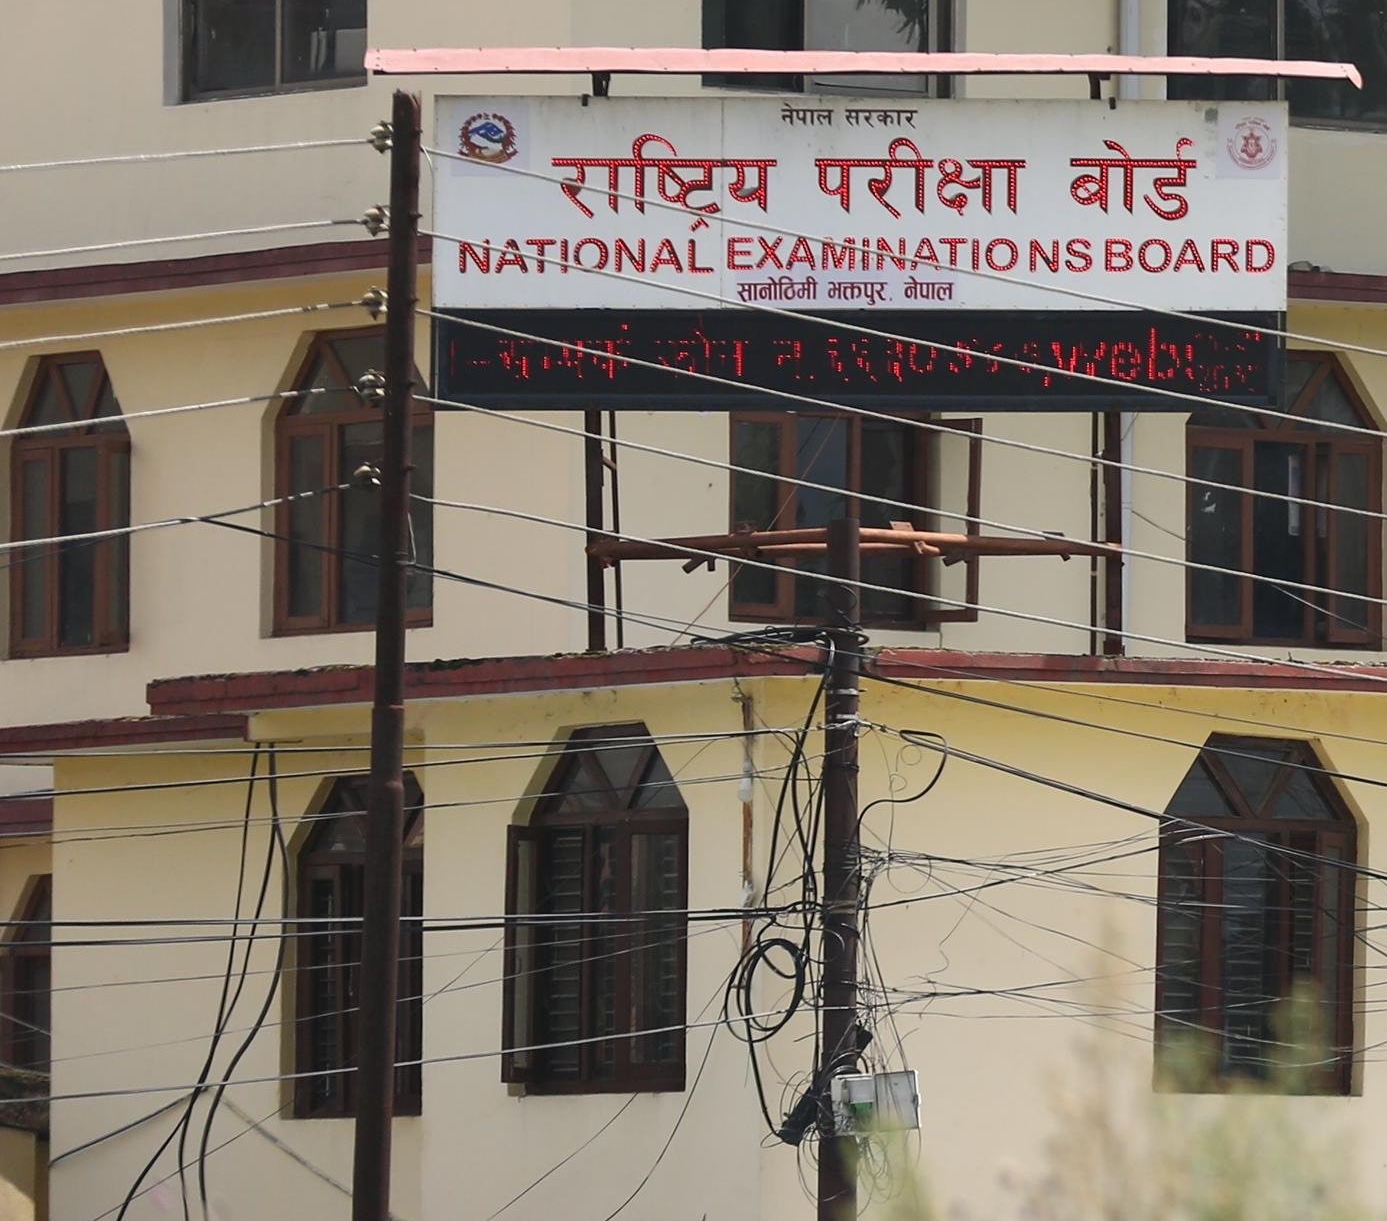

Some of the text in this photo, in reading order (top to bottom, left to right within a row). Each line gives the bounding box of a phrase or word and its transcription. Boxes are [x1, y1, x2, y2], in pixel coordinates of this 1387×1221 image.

[781, 103, 918, 128] नेपाल सरकार
[551, 133, 777, 232] राष्ट्रिय
[814, 137, 1027, 219] परीक्षा
[1070, 137, 1197, 221] बोर्ड
[457, 237, 714, 274] NATIONAL
[1103, 238, 1276, 273] BOARD
[736, 275, 818, 302] सानोठिमी
[903, 275, 954, 301] नेपाल
